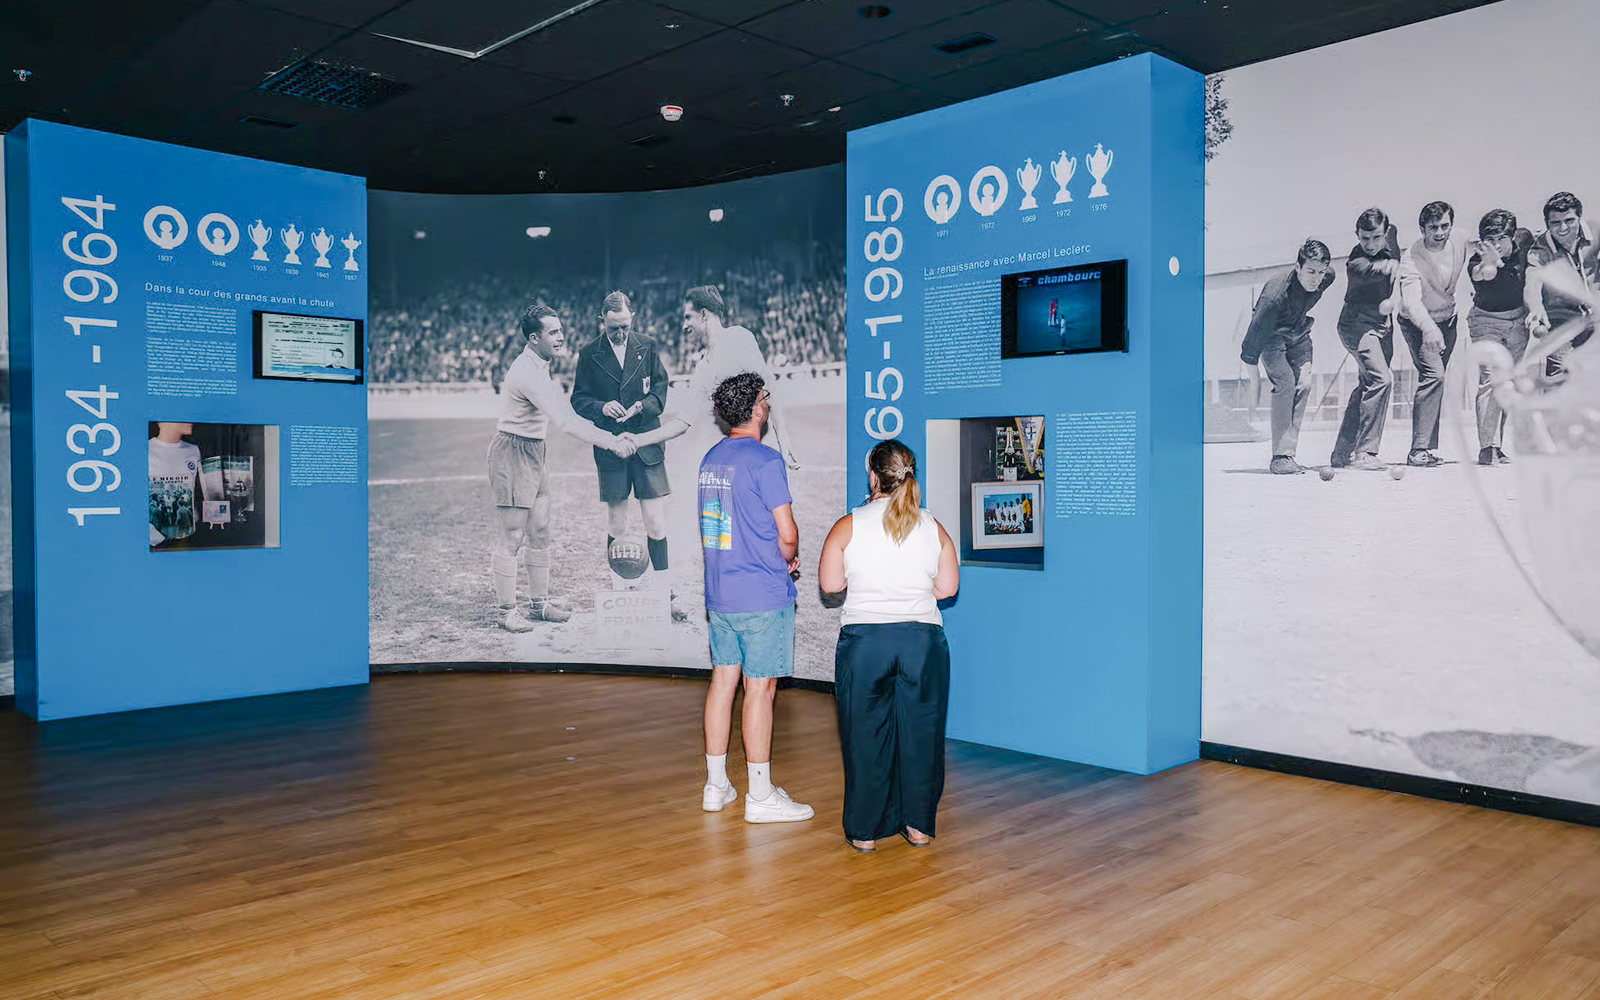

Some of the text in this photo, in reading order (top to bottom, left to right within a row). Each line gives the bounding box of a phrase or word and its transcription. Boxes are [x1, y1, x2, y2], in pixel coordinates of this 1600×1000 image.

[1022, 214, 1037, 223] 1969
[1056, 209, 1072, 218] 1972
[981, 221, 996, 231] 1972
[157, 254, 174, 262] 1937
[923, 267, 935, 276] La
[936, 259, 990, 275] renaissance
[993, 255, 1015, 266] avec
[1018, 248, 1051, 262] Marcel
[1054, 244, 1091, 258] Leclerc
[61, 194, 119, 336] 1964
[211, 260, 227, 268] 1948
[252, 264, 268, 272] 1935
[145, 282, 334, 308] Dans la cour des grands avant la chute
[65, 384, 121, 527] 1934
[602, 597, 662, 611] COUPE
[603, 615, 664, 628] FRANCE
